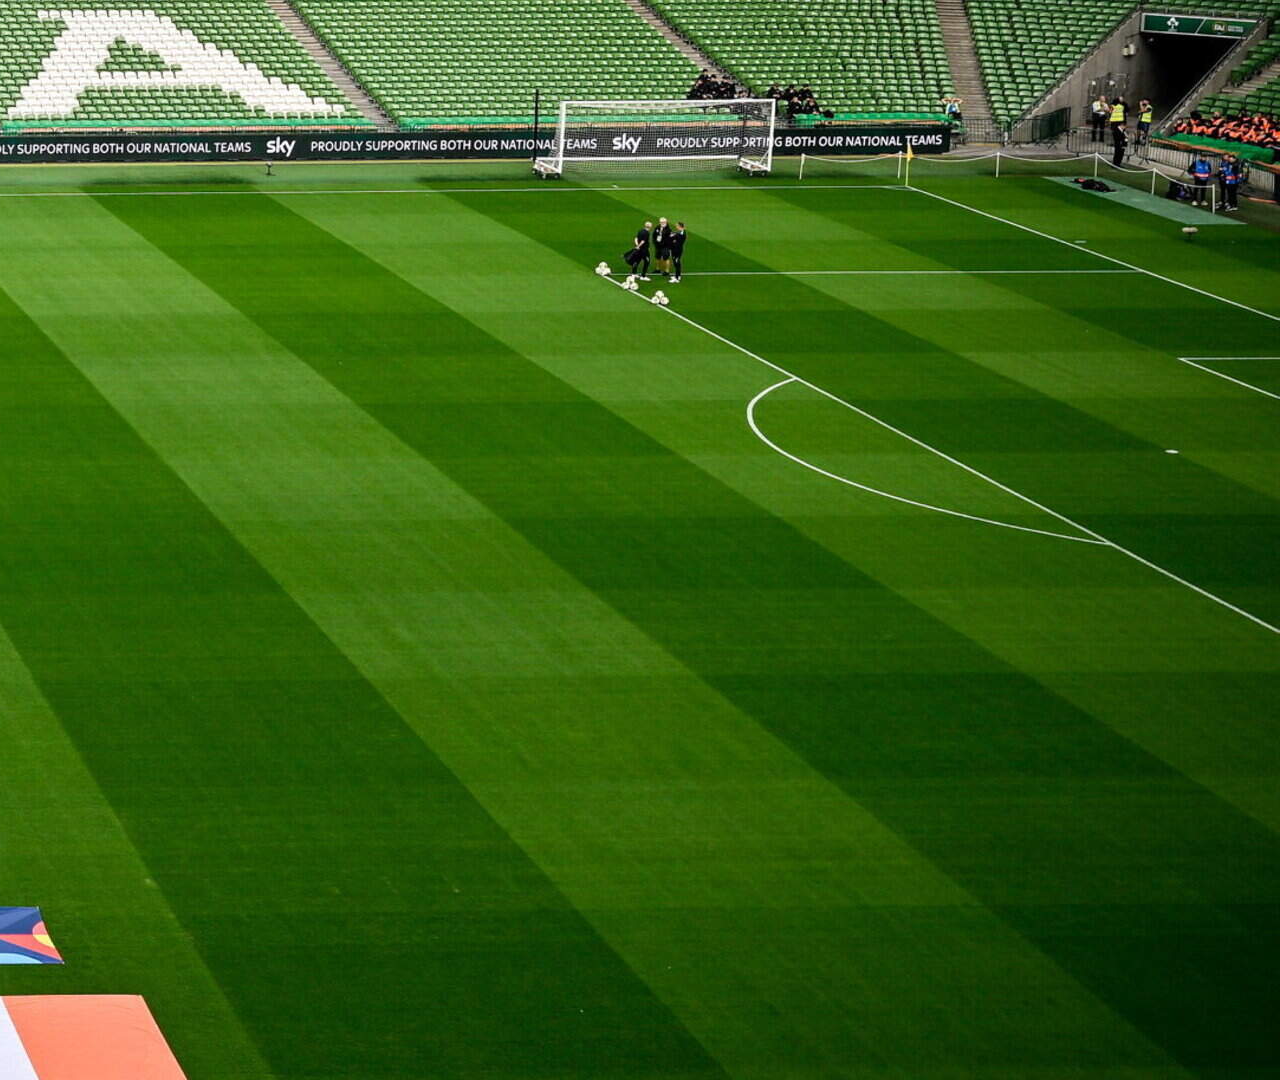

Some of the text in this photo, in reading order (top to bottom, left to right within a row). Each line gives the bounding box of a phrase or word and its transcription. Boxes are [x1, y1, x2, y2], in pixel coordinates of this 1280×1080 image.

[17, 144, 89, 154] SUPPORTING
[93, 143, 123, 153] BOTH
[127, 143, 151, 153] OUR
[154, 143, 211, 153] NATIONAL
[214, 142, 251, 152] TEAMS
[267, 137, 295, 157] sky
[311, 141, 363, 151] PROUDLY
[366, 140, 437, 151] SUPPORTING
[441, 140, 471, 150] BOTH
[474, 140, 498, 150] OUR
[500, 139, 557, 150] NATIONAL
[613, 133, 641, 153] sky
[657, 138, 708, 148] PROUDLY
[785, 137, 816, 146] BOTH
[819, 136, 843, 146] OUR
[846, 136, 902, 146] NATIONAL
[905, 135, 942, 146] TEAMS
